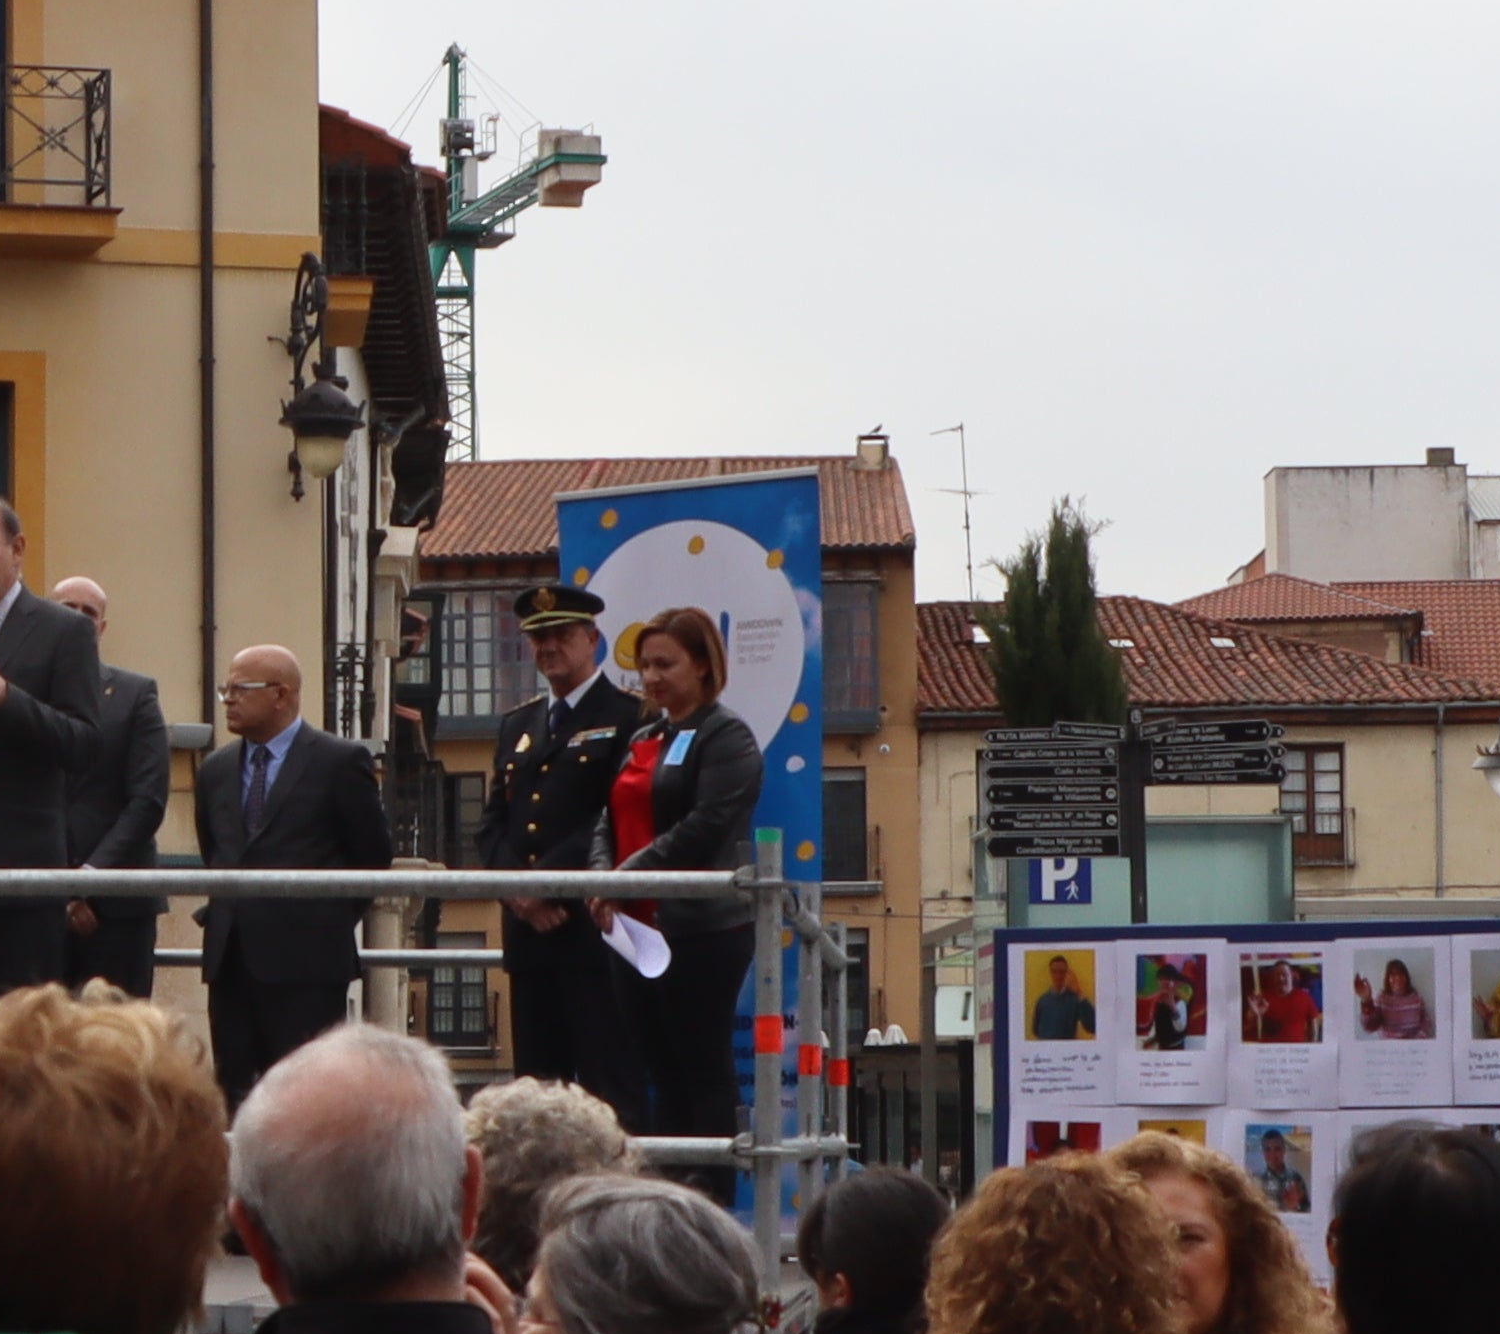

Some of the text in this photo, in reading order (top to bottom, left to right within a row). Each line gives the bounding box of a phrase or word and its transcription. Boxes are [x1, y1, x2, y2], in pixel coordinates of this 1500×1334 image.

[996, 730, 1018, 740] RUTA
[1019, 730, 1050, 740] BARRIO
[1054, 766, 1074, 775] Calle
[1033, 838, 1056, 846] Plaza
[1056, 838, 1081, 847] Mayor
[1016, 845, 1065, 855] Constitución
[1040, 857, 1079, 901] P
